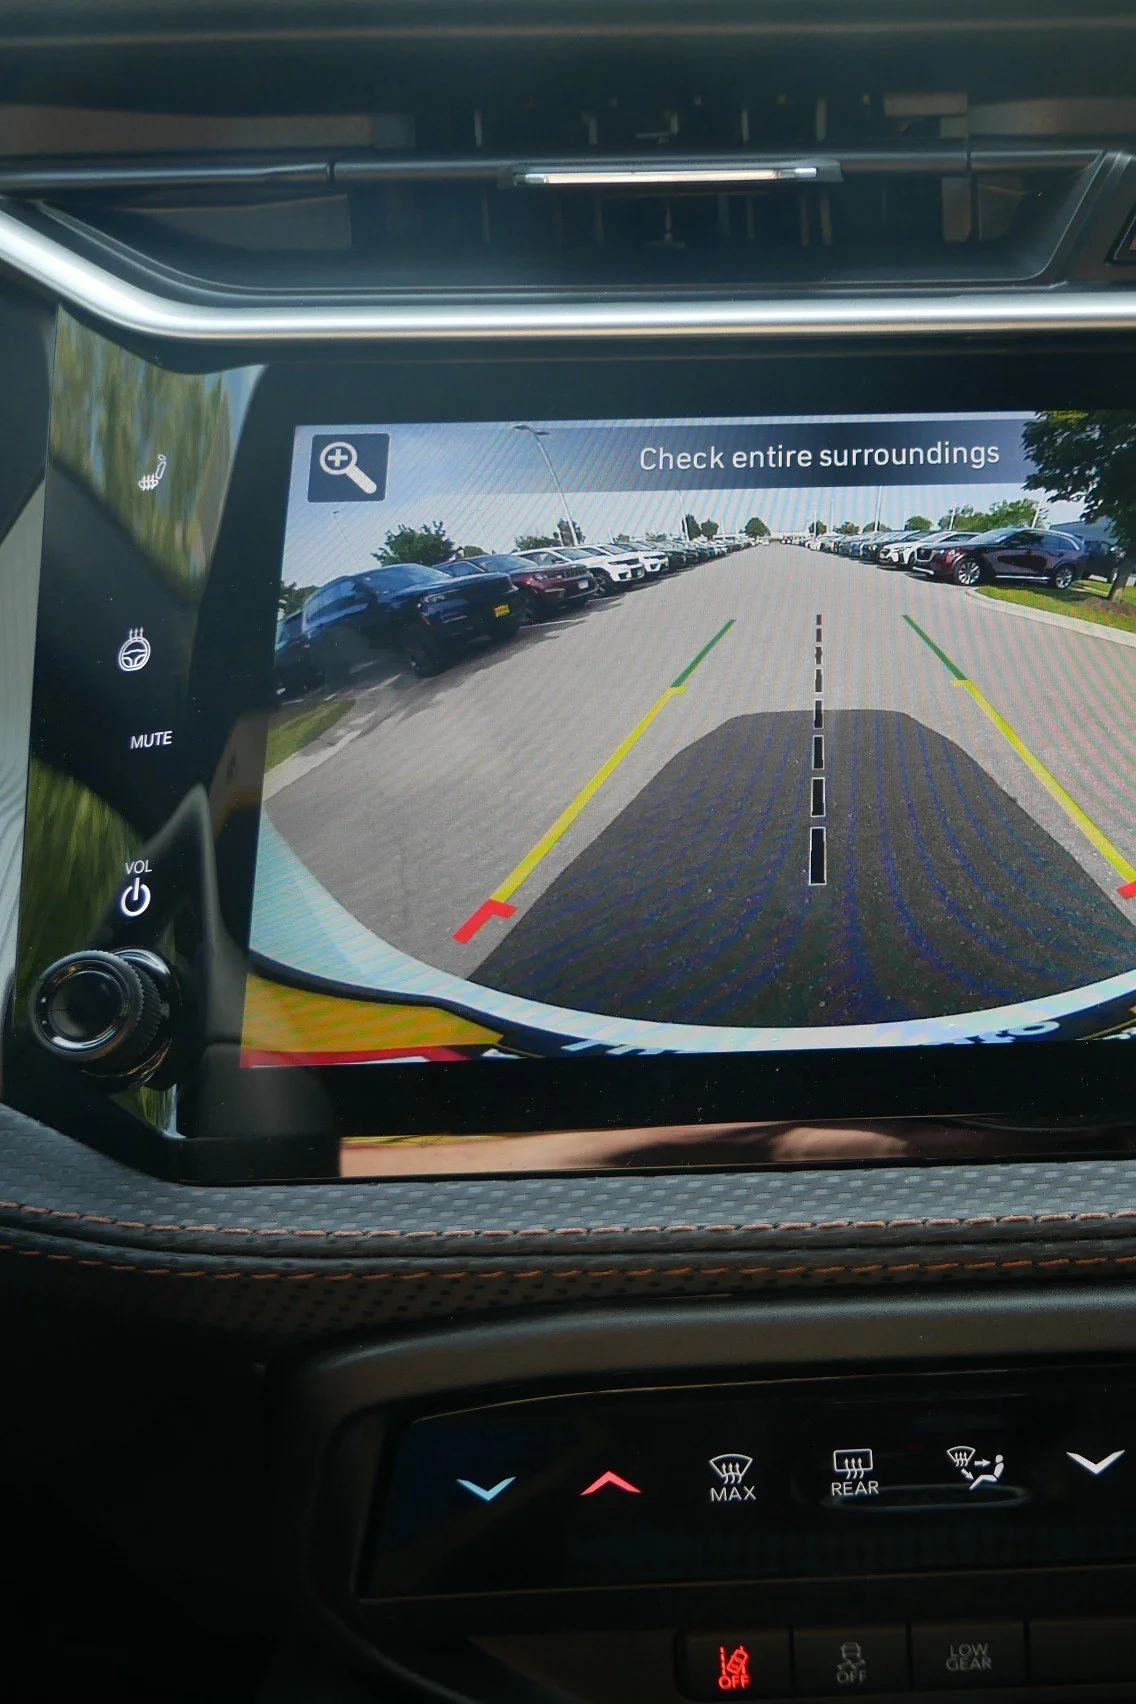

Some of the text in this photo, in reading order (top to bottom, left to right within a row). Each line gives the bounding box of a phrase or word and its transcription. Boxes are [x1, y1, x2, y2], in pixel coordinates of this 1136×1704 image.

[639, 440, 1000, 471] Check entire surroundings
[130, 730, 173, 750] MUTE
[125, 859, 153, 875] VOL
[710, 1484, 757, 1502] MAX
[831, 1480, 880, 1497] REAR
[950, 1643, 990, 1657] LOW
[946, 1657, 992, 1672] GEAR
[718, 1674, 750, 1690] OFF
[836, 1670, 868, 1685] OFF
